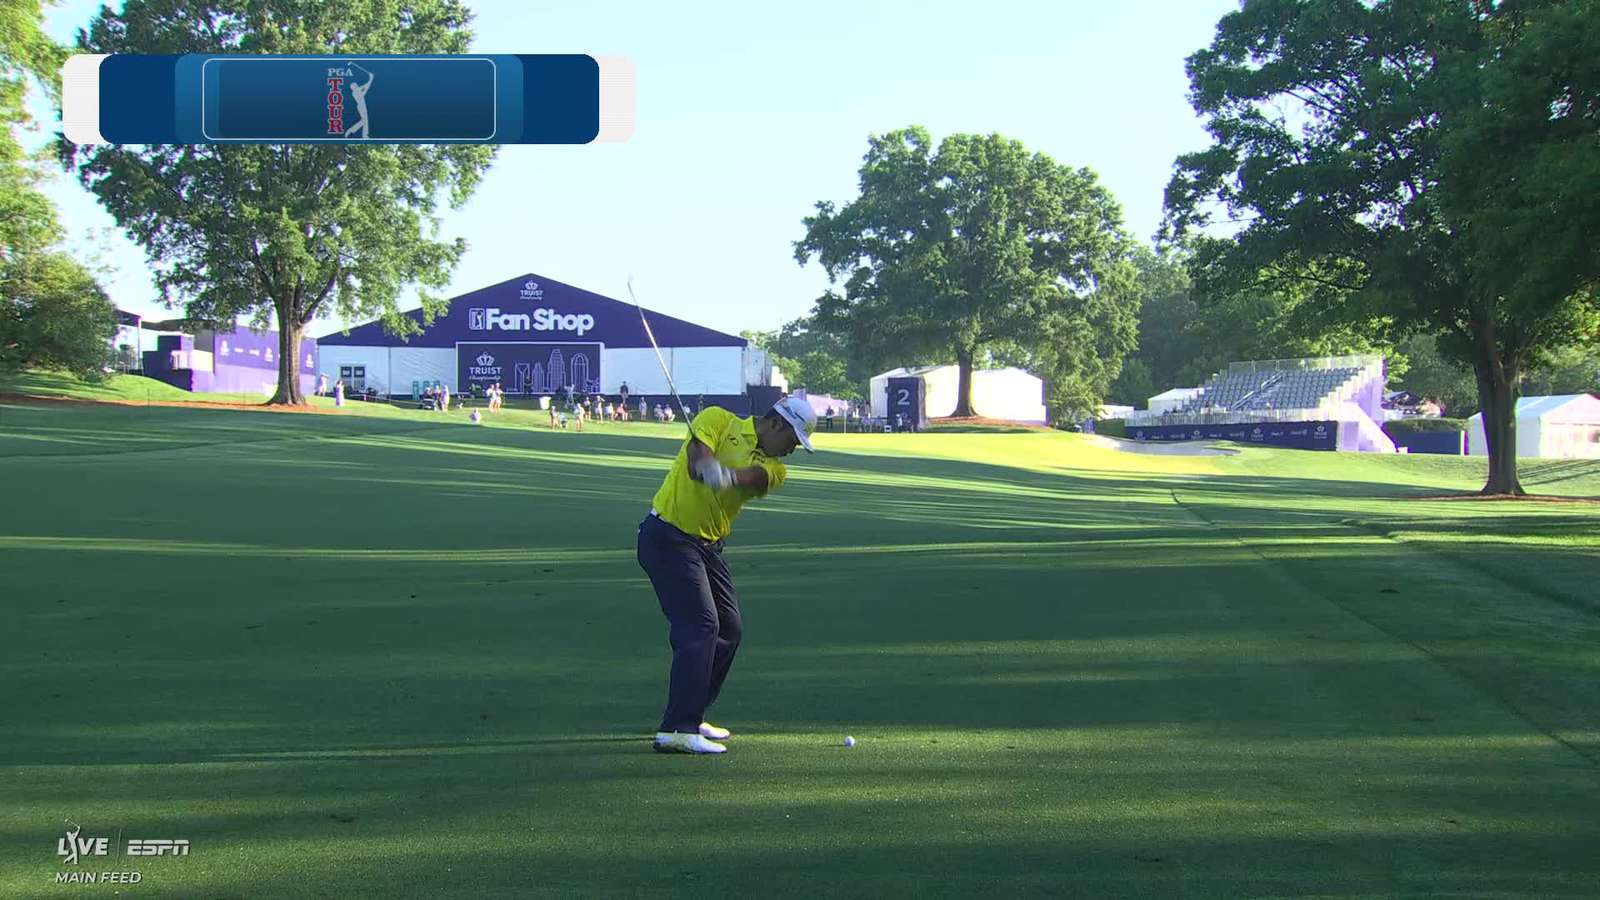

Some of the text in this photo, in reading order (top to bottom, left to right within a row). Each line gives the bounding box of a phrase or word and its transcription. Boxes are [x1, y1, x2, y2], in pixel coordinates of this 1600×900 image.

[486, 308, 530, 330] Fan
[533, 308, 594, 336] Shop
[469, 367, 501, 375] TRUIST
[897, 389, 910, 405] 2
